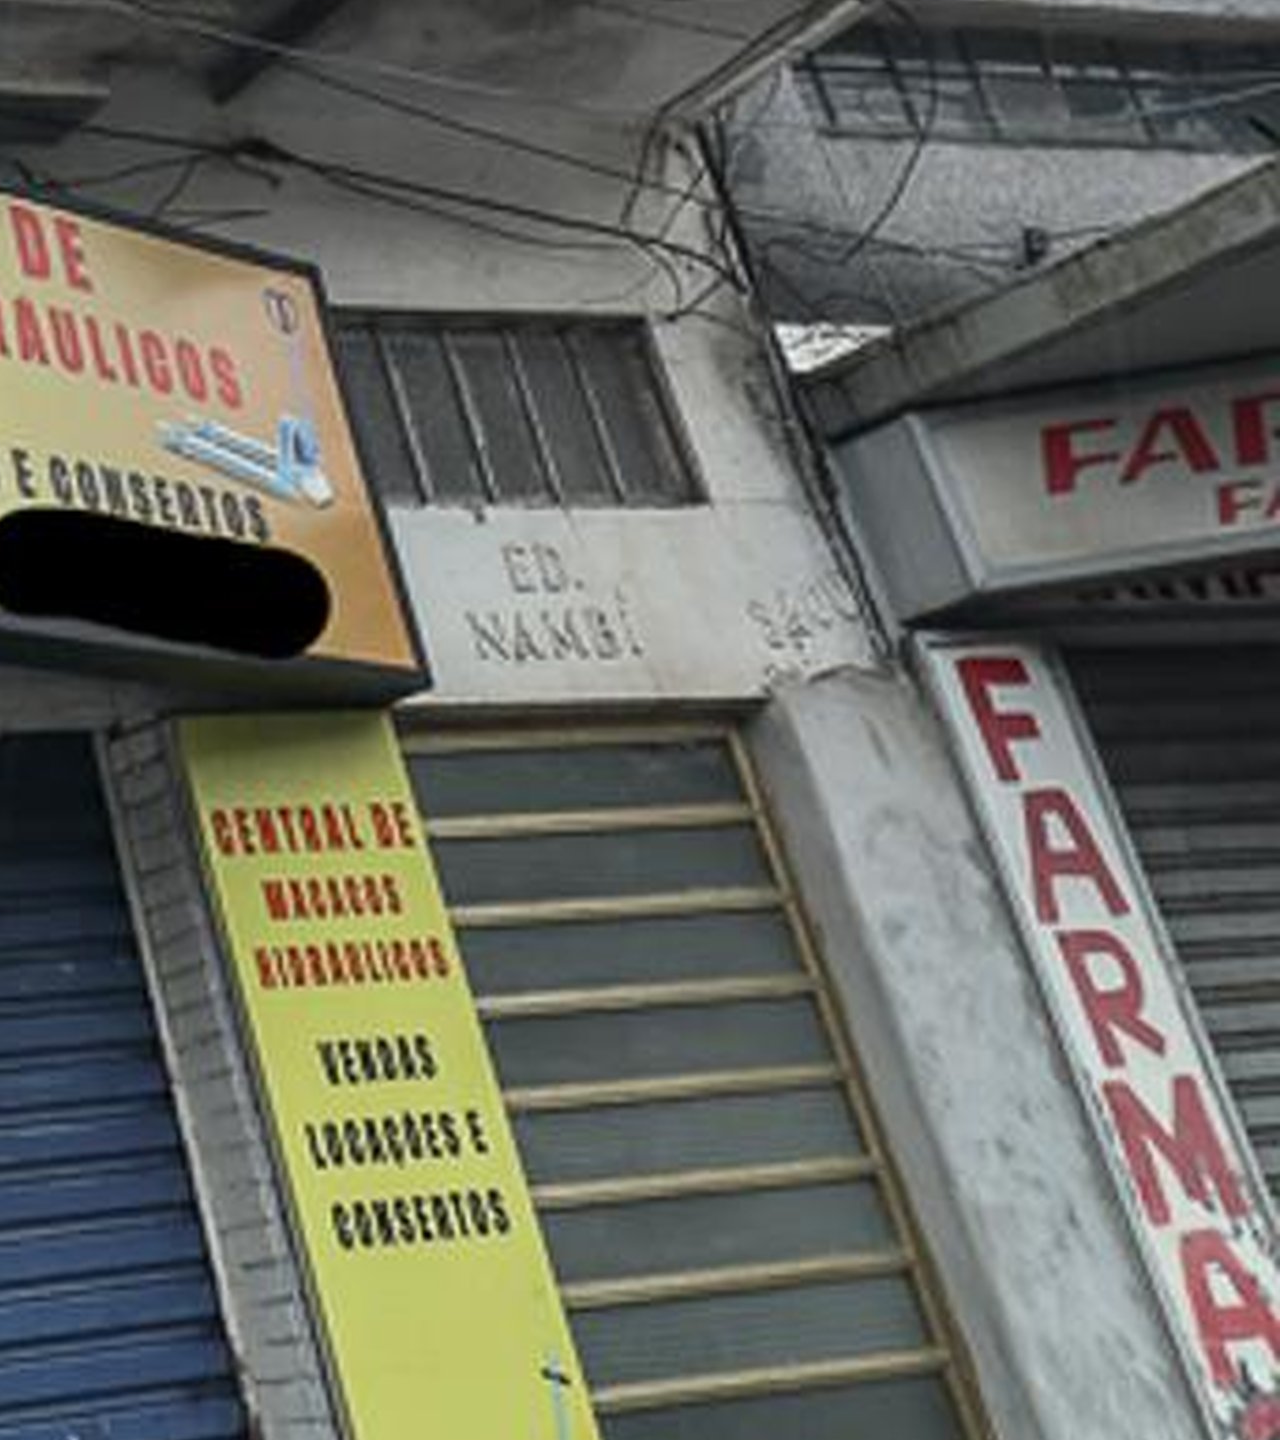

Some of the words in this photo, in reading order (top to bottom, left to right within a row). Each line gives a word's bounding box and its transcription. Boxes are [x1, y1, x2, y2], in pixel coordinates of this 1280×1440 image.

[11, 199, 93, 292] DE
[12, 448, 38, 499] E
[49, 456, 271, 540] CONSERTOS
[211, 803, 365, 856] CENTRAL
[370, 802, 415, 848] DE
[262, 873, 402, 920] MACACOS
[316, 1035, 437, 1086] VENDAS
[466, 1110, 488, 1154] E
[332, 1189, 510, 1250] CONSERTOS
